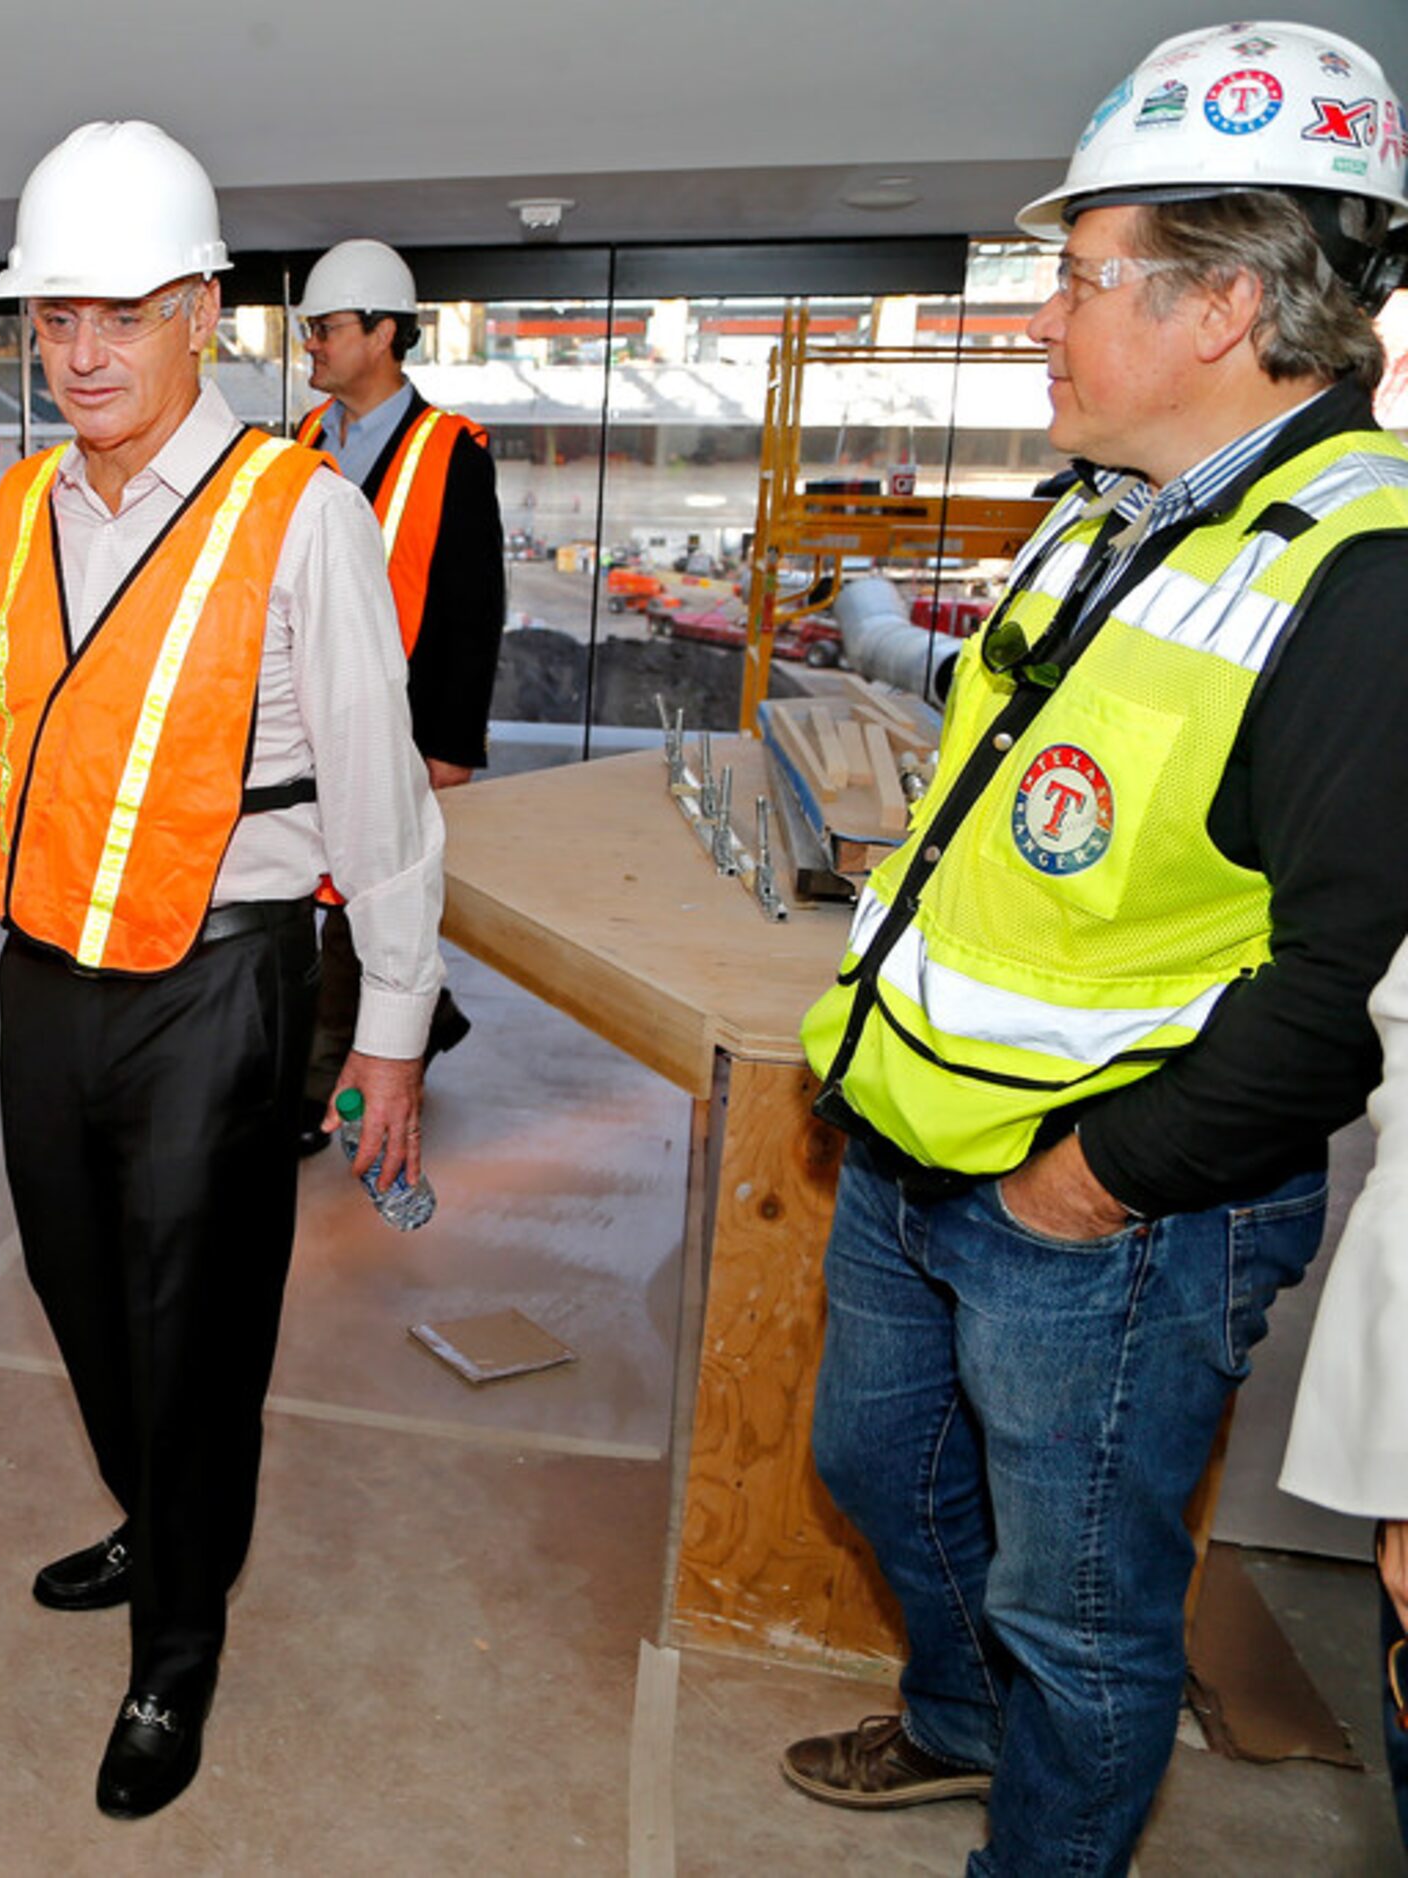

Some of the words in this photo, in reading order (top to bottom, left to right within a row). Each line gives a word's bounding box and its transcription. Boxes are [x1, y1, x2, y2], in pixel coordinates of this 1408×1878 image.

[1229, 87, 1261, 117] T
[1035, 751, 1108, 799] TEXAS
[1013, 801, 1103, 869] RANGERS
[1044, 779, 1087, 842] T
